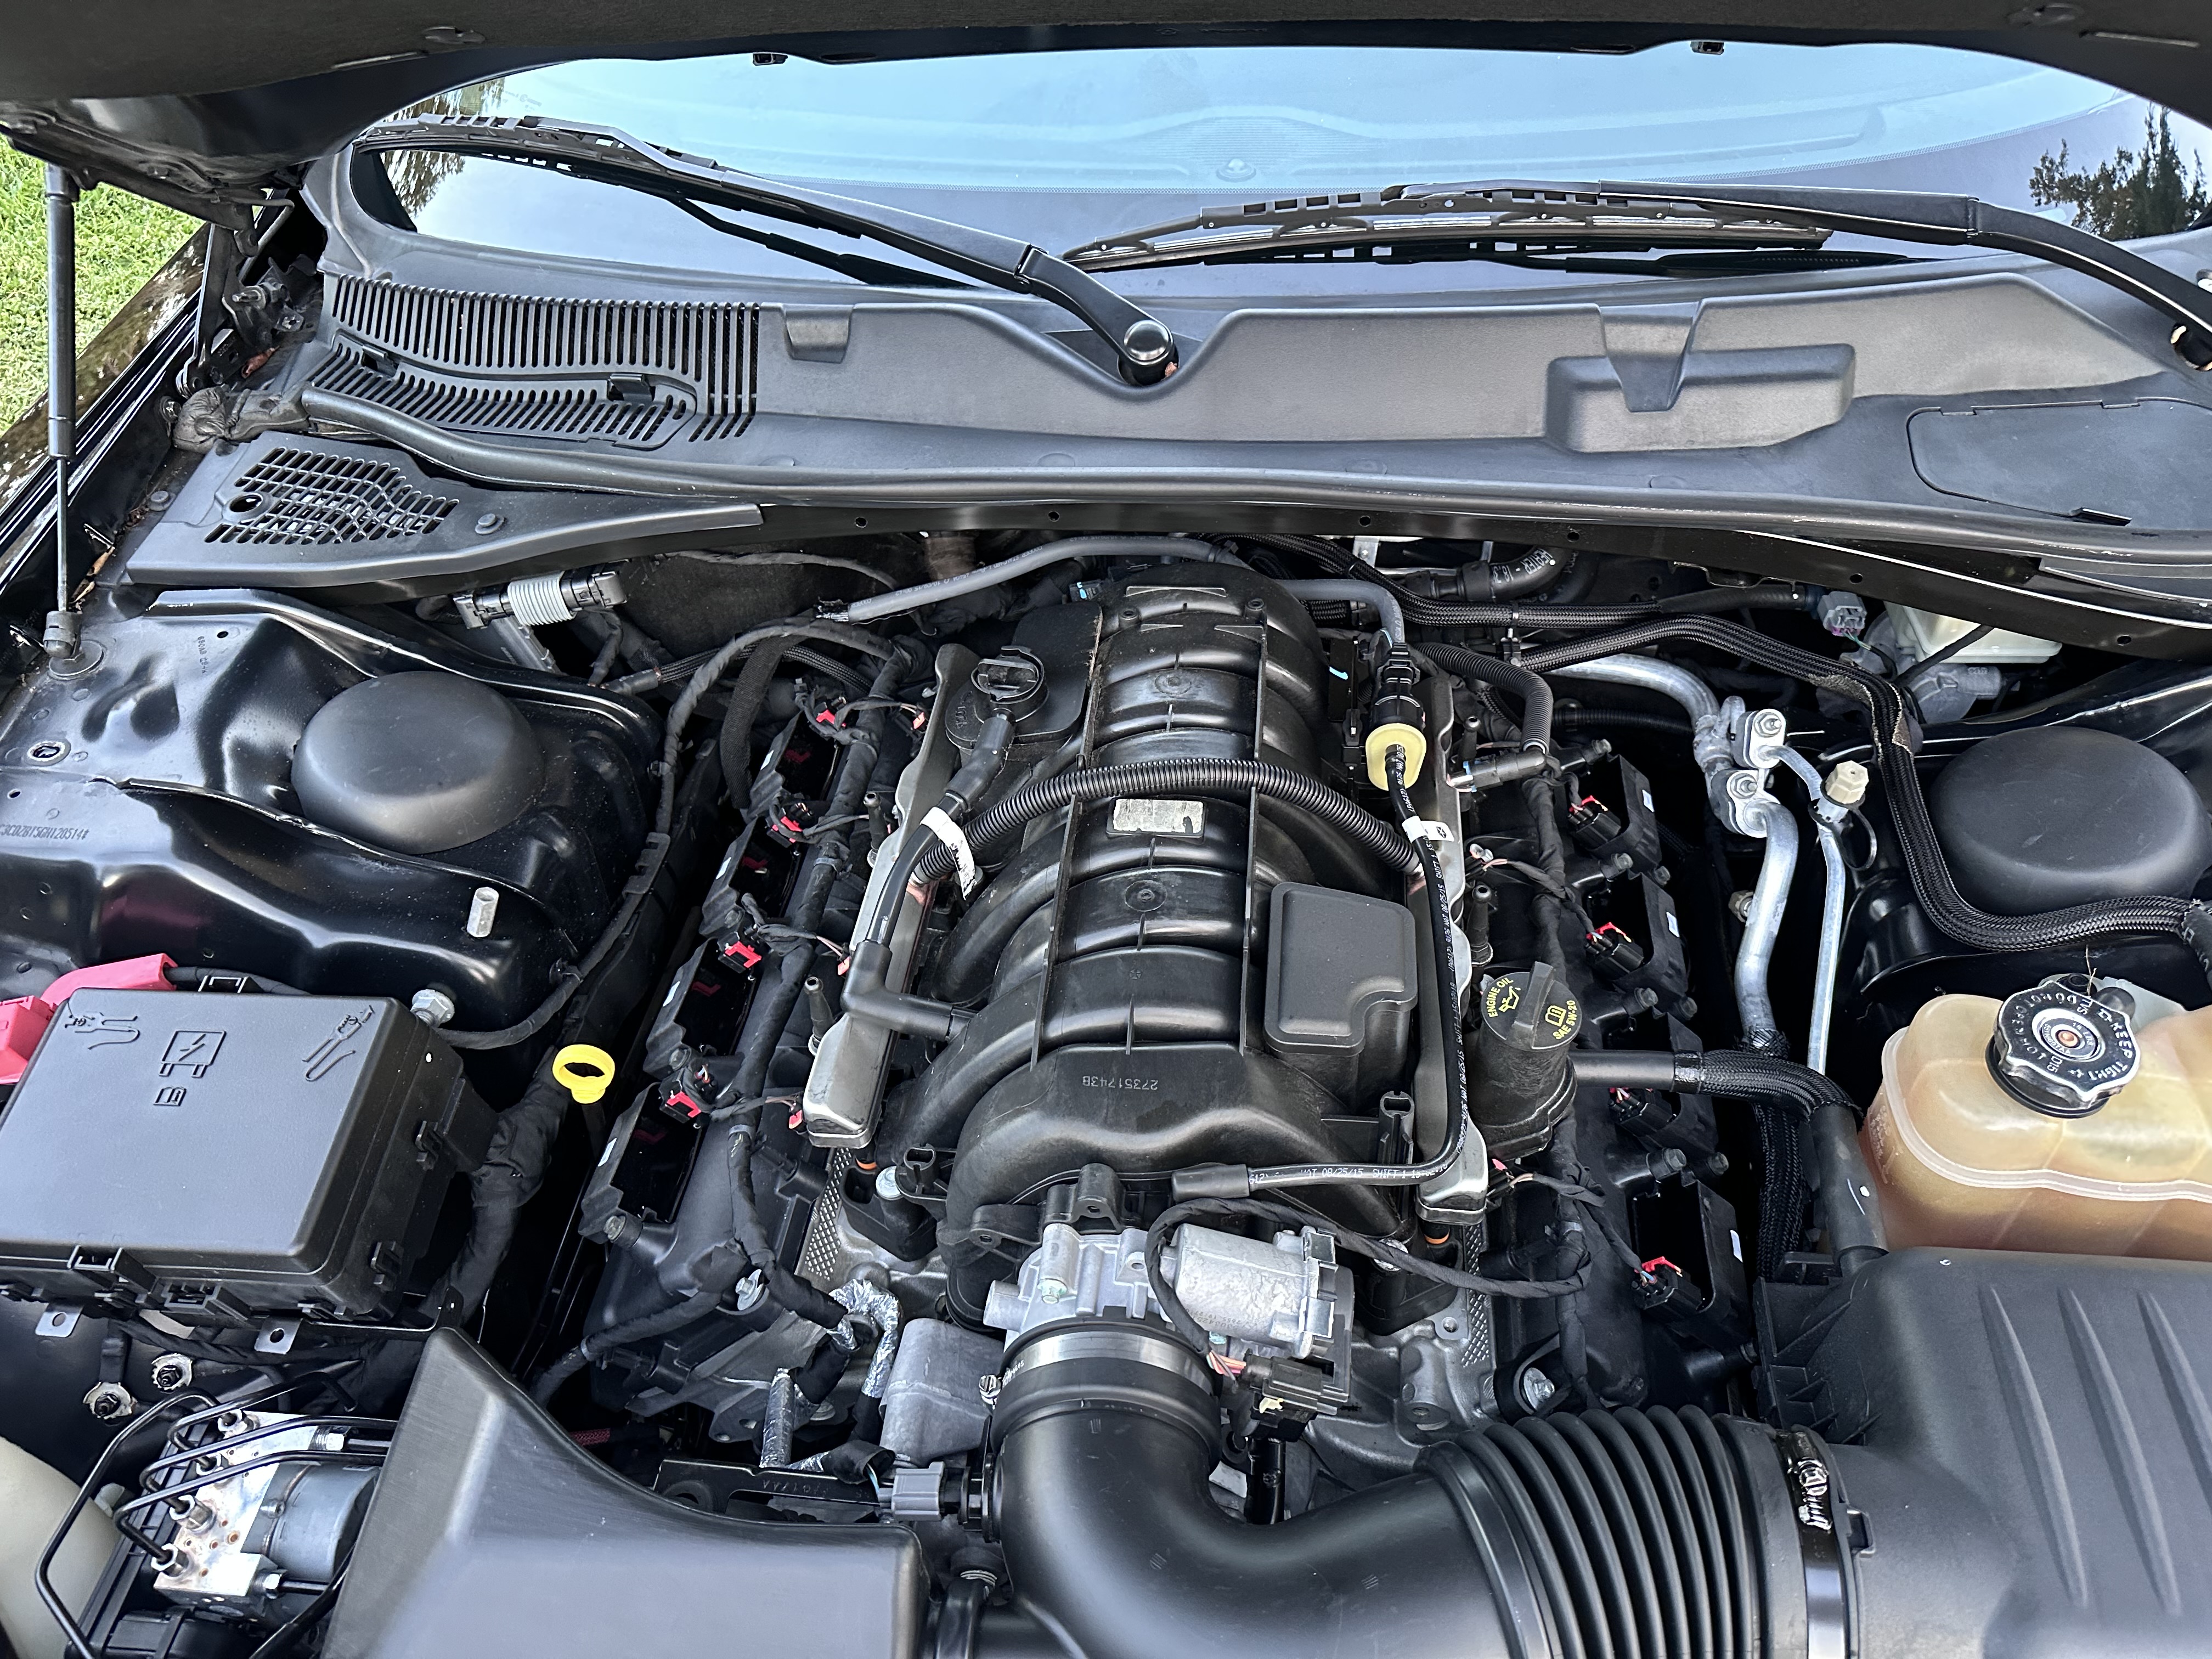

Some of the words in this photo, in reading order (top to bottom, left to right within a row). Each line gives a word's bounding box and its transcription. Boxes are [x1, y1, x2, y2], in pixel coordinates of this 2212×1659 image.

[1521, 548, 1553, 575] HEATER
[1486, 986, 1500, 1018] ENGINE
[1496, 977, 1514, 989] OIL
[1553, 1024, 1571, 1040] SAE
[1565, 1000, 1576, 1026] 5W-20
[2109, 1022, 2133, 1058] KEEP
[2047, 1056, 2063, 1073] D15
[2088, 1062, 2128, 1081] TIGHT
[1322, 1168, 1364, 1178] 08/25/15
[1372, 1169, 1399, 1178] SHIFT
